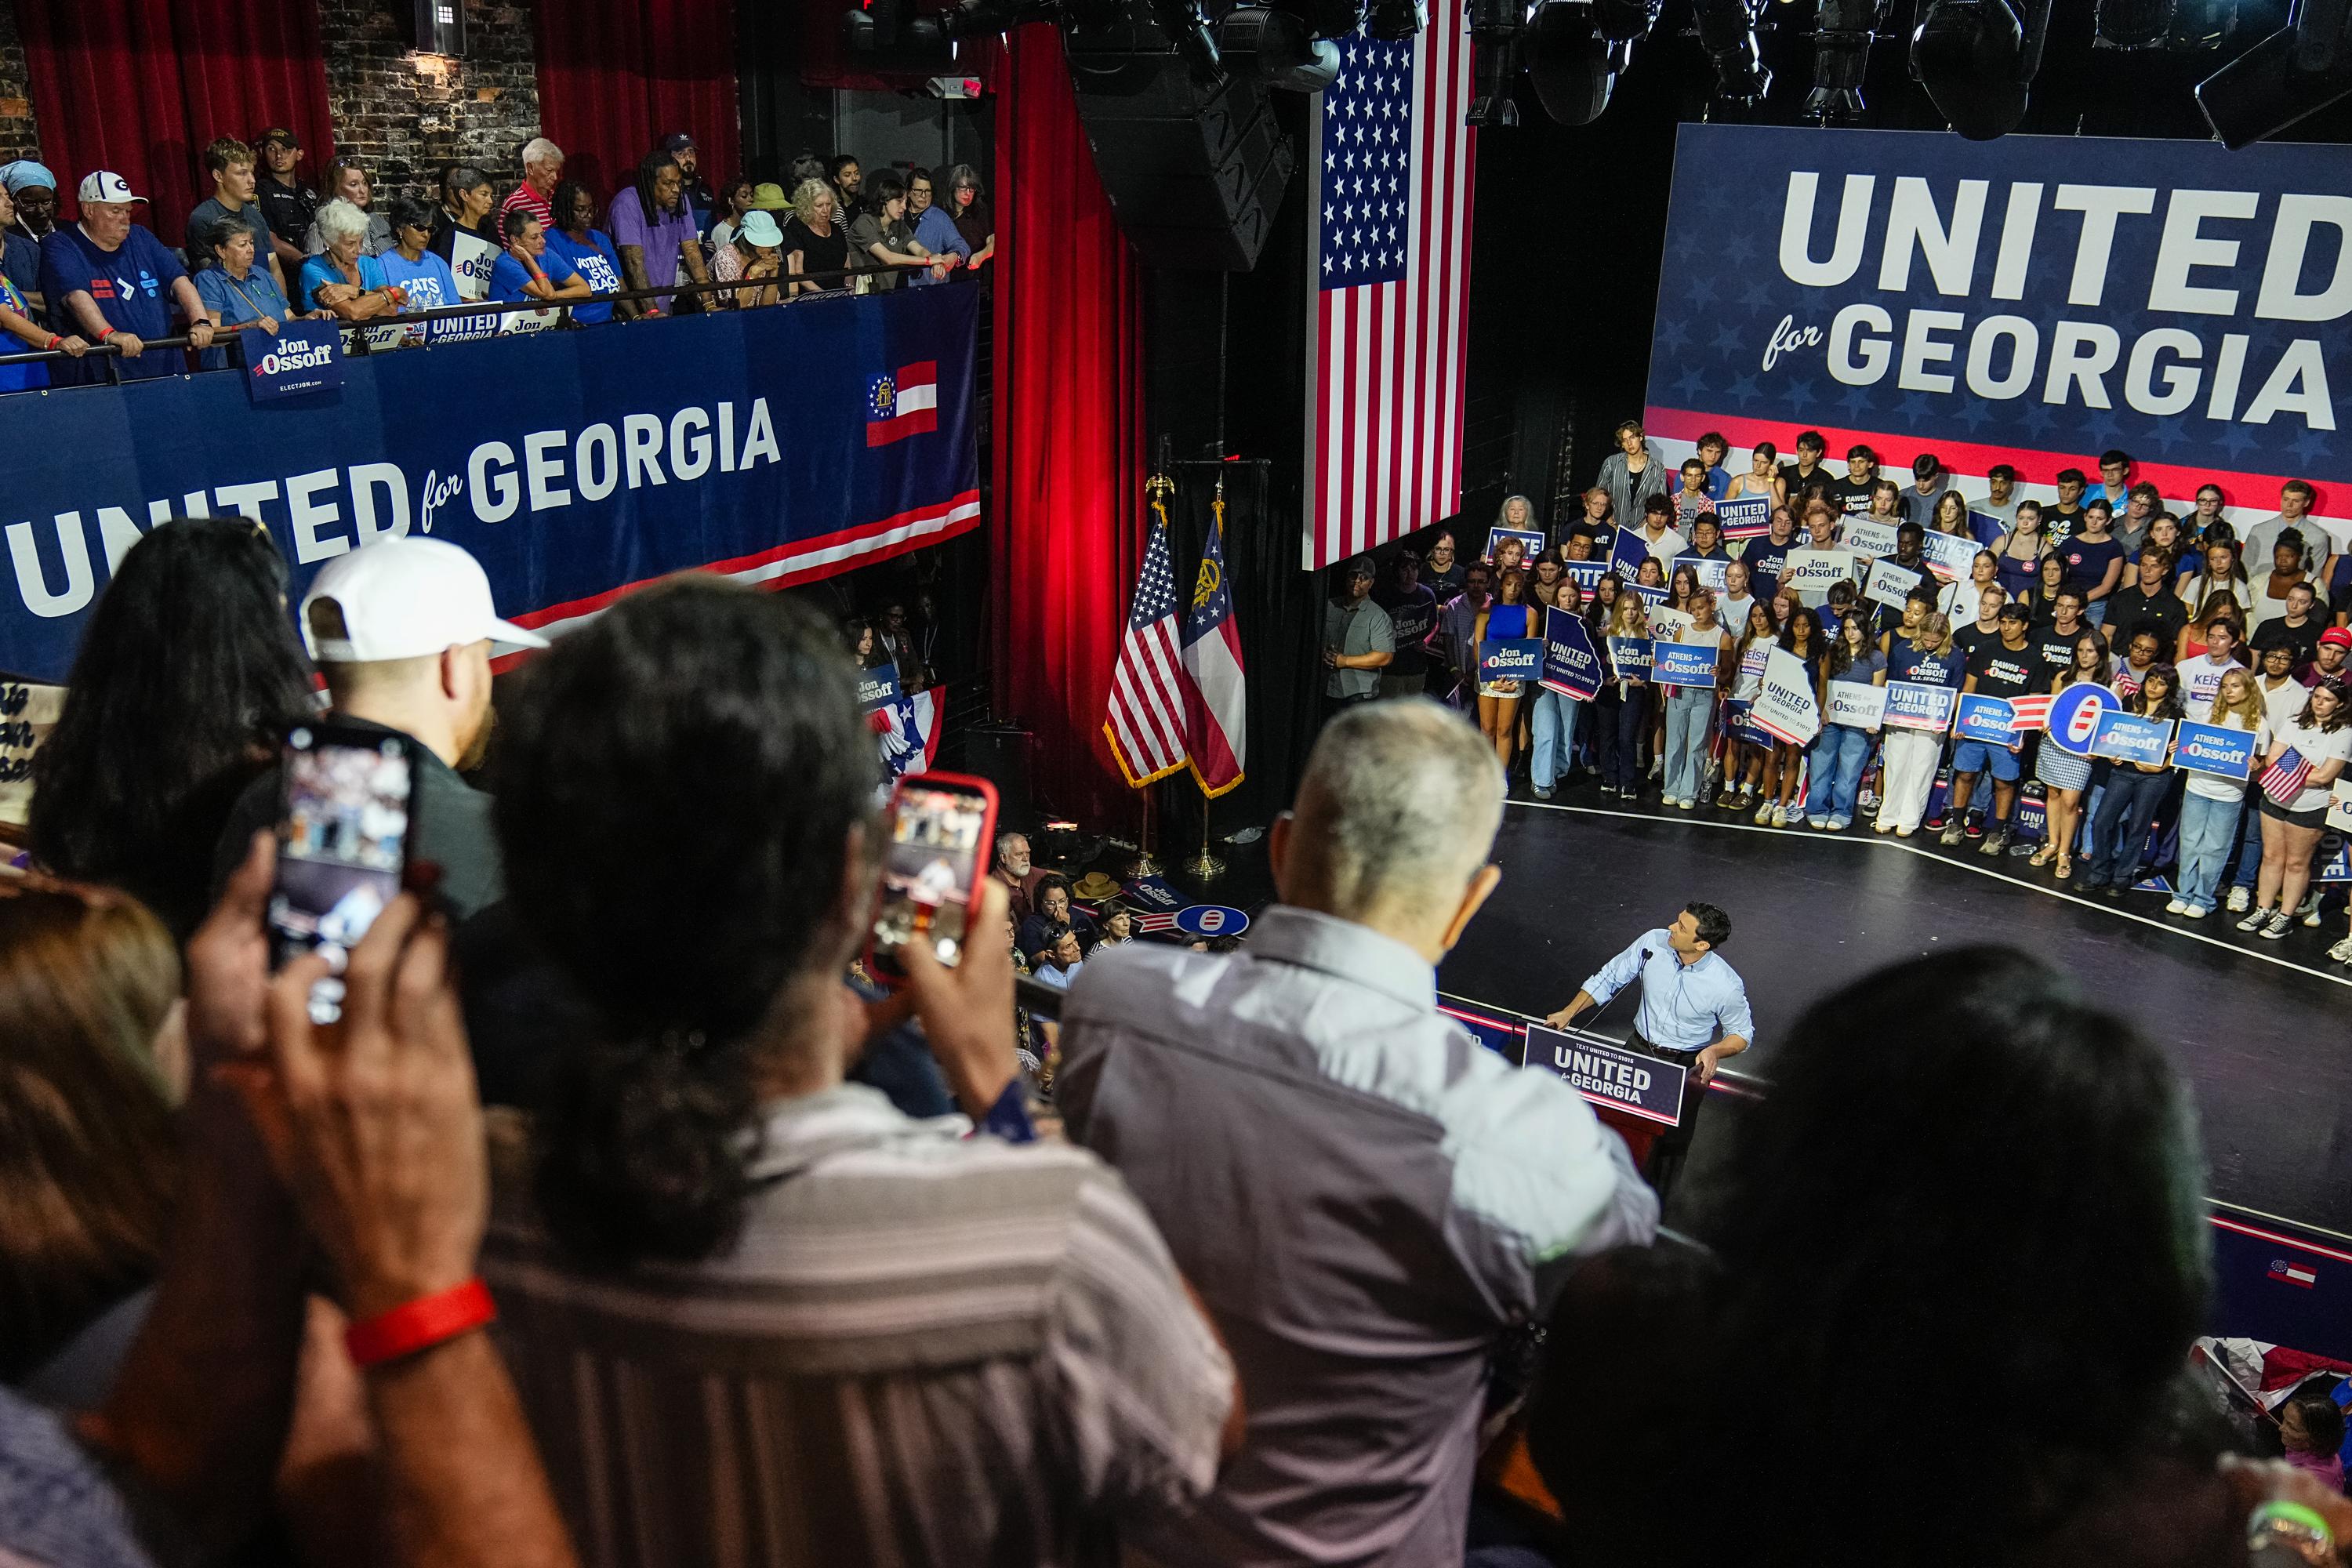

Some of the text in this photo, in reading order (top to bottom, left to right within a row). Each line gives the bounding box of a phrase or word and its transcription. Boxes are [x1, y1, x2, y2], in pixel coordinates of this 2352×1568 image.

[1779, 170, 2352, 322] UNITED
[463, 260, 492, 282] Oss
[400, 277, 440, 296] CATS
[433, 314, 497, 335] UNITED
[515, 319, 541, 331] Jon
[278, 339, 310, 355] Jon
[262, 344, 332, 375] Ossoff
[1762, 304, 2337, 431] for GEORGIA
[5, 397, 782, 618] UNTED for GEORGIA
[1720, 503, 1766, 517] UNITED
[1727, 515, 1766, 526] GEORGIA
[1595, 535, 1610, 544] off
[1855, 528, 1880, 539] ATHENS
[1493, 535, 1541, 555] VTE
[1849, 535, 1896, 554] Ossoff
[1615, 558, 1639, 575] UNIT
[1758, 559, 1782, 570] Osso
[1767, 555, 1784, 564] Jon
[1809, 559, 1829, 568] Jon
[1568, 568, 1606, 586] OTE
[1796, 566, 1844, 578] Ossoff
[1882, 572, 1902, 584] ATHENS
[1396, 619, 1416, 630] Jon
[1668, 619, 1686, 628] Jo
[1499, 648, 1520, 658] Jon
[1550, 641, 1592, 665] UNITED
[1617, 645, 1639, 655] Jon
[1745, 649, 1769, 662] EISH
[2042, 644, 2072, 655] DAWGS
[1488, 654, 1535, 668] Ossoff
[1556, 654, 1586, 670] GEORGIA
[1668, 652, 1693, 662] ATHENS
[1555, 666, 1574, 677] UNITED
[1664, 660, 1711, 675] Ossoff
[1910, 666, 1948, 678] Ossoff
[1920, 660, 1940, 670] Jon
[1991, 659, 2020, 672] DAWGS
[1989, 667, 2027, 684] Ossoff
[2194, 673, 2220, 686] KEIS
[859, 680, 878, 692] Jon
[1767, 682, 1811, 710] UNITED
[1837, 691, 1862, 701] ATHENS
[1892, 688, 1948, 708] UNITED
[1772, 695, 1802, 716] GEORGIA
[1834, 700, 1878, 717] Ossoff
[1896, 702, 1945, 717] GEORGIA
[1974, 705, 2002, 717] ATHENS
[1770, 708, 1789, 720] UNITED
[2111, 722, 2142, 734] ATHENS
[2107, 731, 2161, 751] Ossoff
[2193, 733, 2225, 746] ATHENS
[2188, 742, 2245, 764] Ossoff
[2020, 810, 2045, 824] UNI
[1138, 884, 1177, 906] Ossoff
[1154, 886, 1172, 898] Jon
[1576, 1043, 1589, 1051] TEXT
[1589, 1047, 1610, 1057] UNITED
[1618, 1054, 1634, 1064] 51015
[1555, 1046, 1651, 1091] UNITED
[1571, 1073, 1642, 1104] GEORGIA
